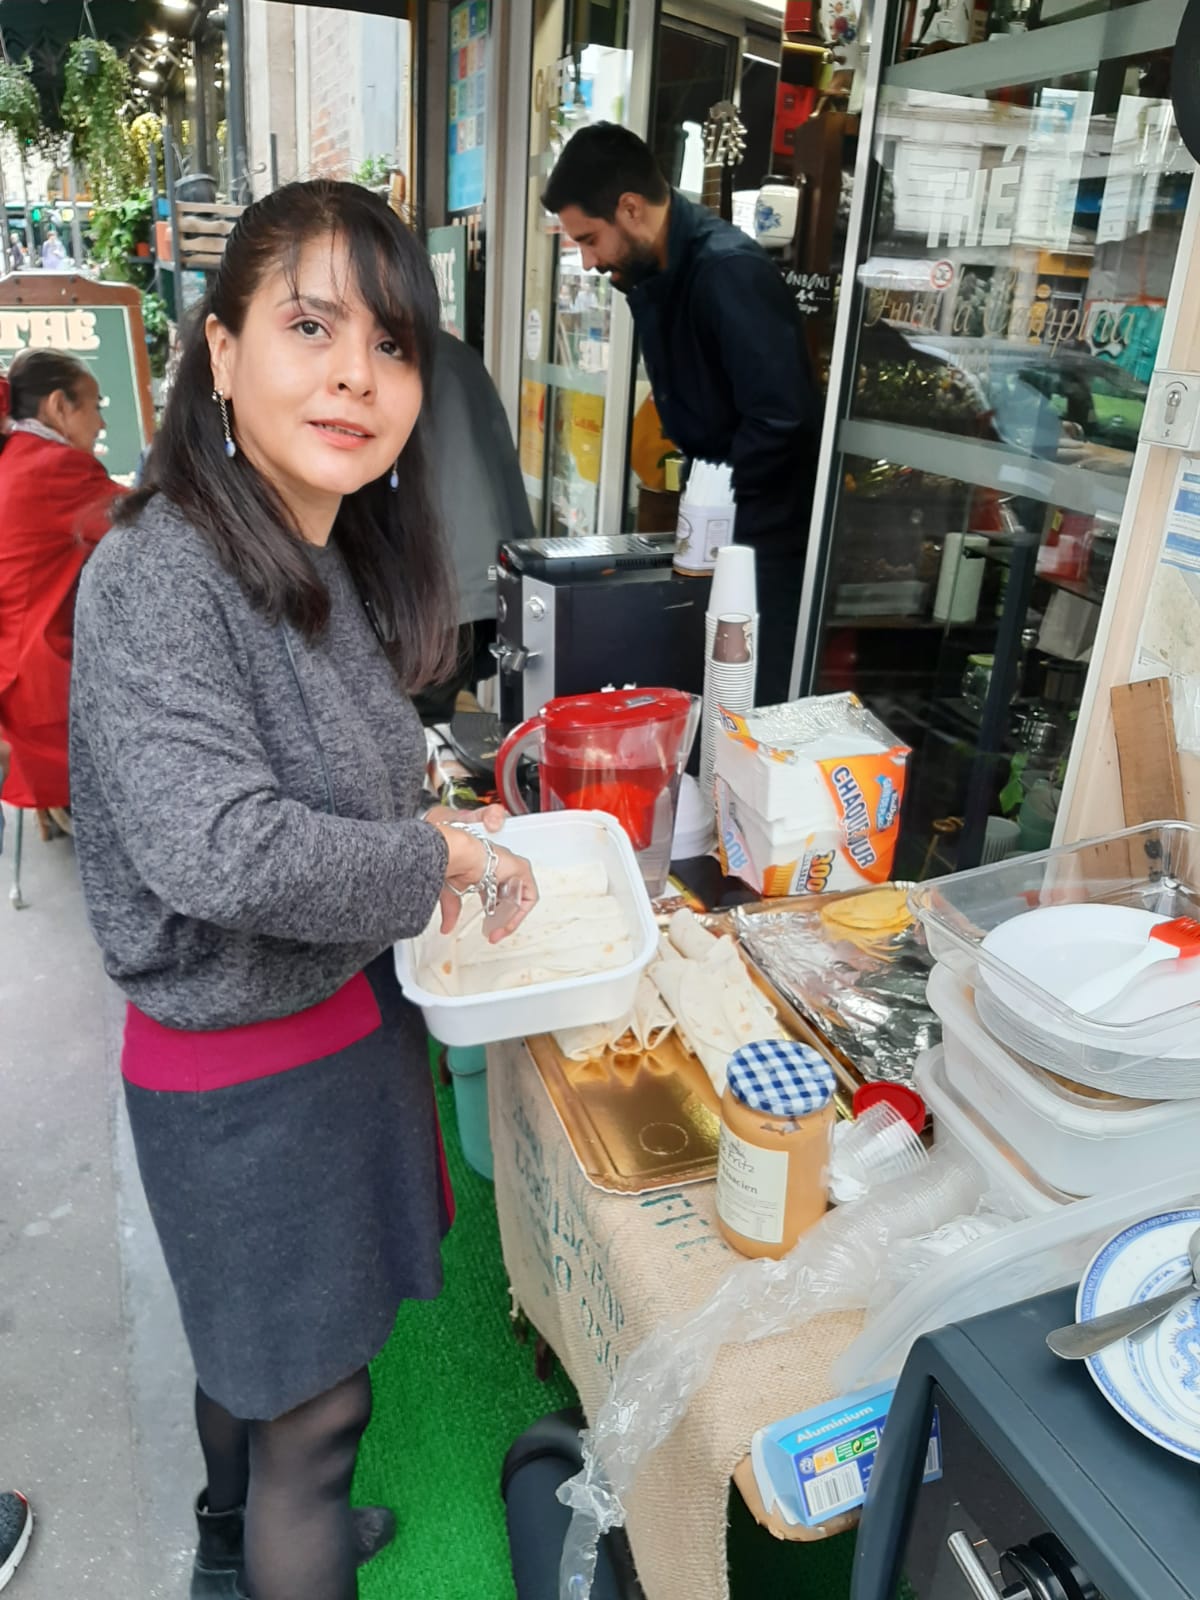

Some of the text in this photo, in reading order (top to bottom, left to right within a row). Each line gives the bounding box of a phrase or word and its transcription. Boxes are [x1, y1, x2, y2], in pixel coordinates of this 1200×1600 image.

[926, 144, 1021, 248] THÉ
[805, 849, 836, 893] 300
[795, 1405, 874, 1445] Aluminium
